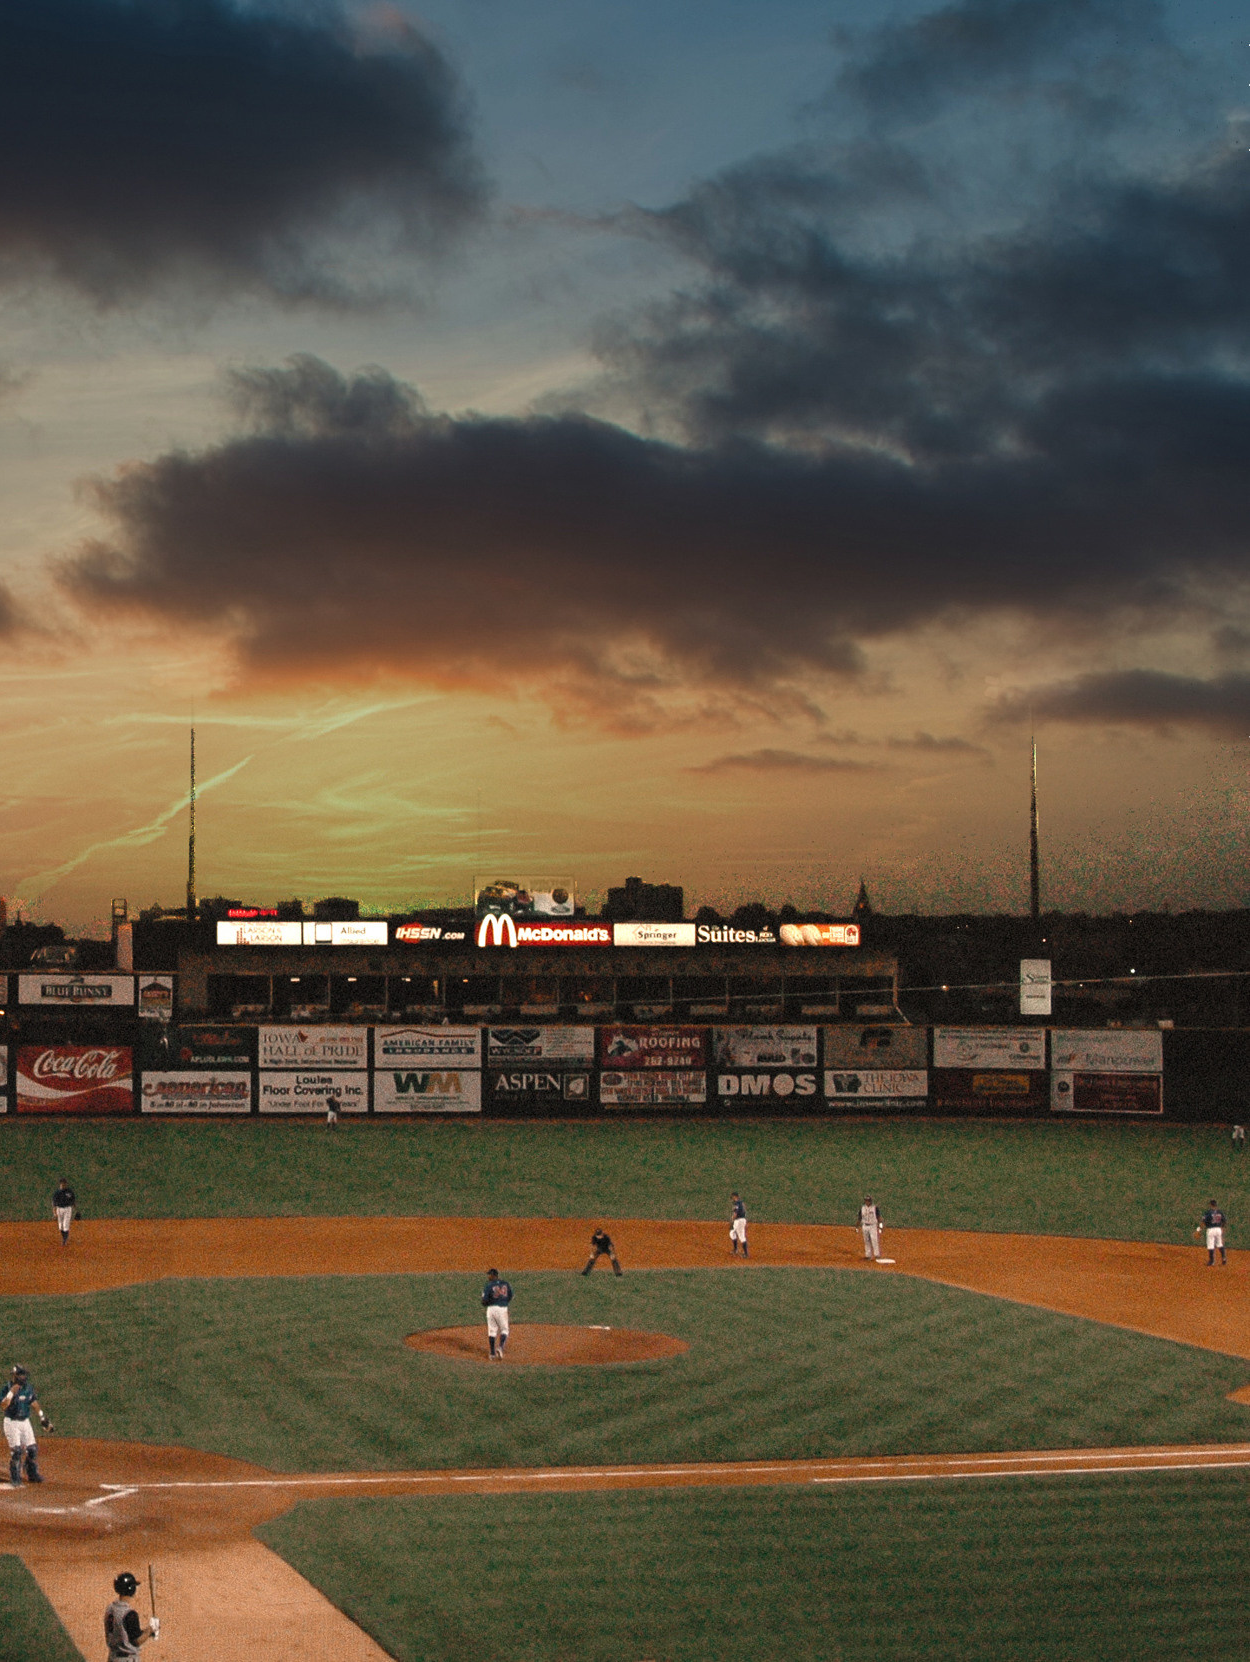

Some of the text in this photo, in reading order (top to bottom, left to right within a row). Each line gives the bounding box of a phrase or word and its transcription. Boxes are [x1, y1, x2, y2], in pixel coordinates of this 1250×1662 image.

[517, 928, 611, 941] McDonald's
[637, 930, 677, 941] Springer
[697, 925, 756, 943] Suites
[263, 1033, 301, 1043] IOWA
[638, 1037, 701, 1049] ROOFING
[263, 1046, 301, 1057] HALL
[322, 1046, 364, 1057] PRIDE
[32, 1049, 123, 1079] Coca-Cola
[495, 1073, 562, 1091] ASPEN
[263, 1085, 290, 1095] Floor
[294, 1085, 342, 1097] Covering
[863, 1084, 903, 1093] CLINIC
